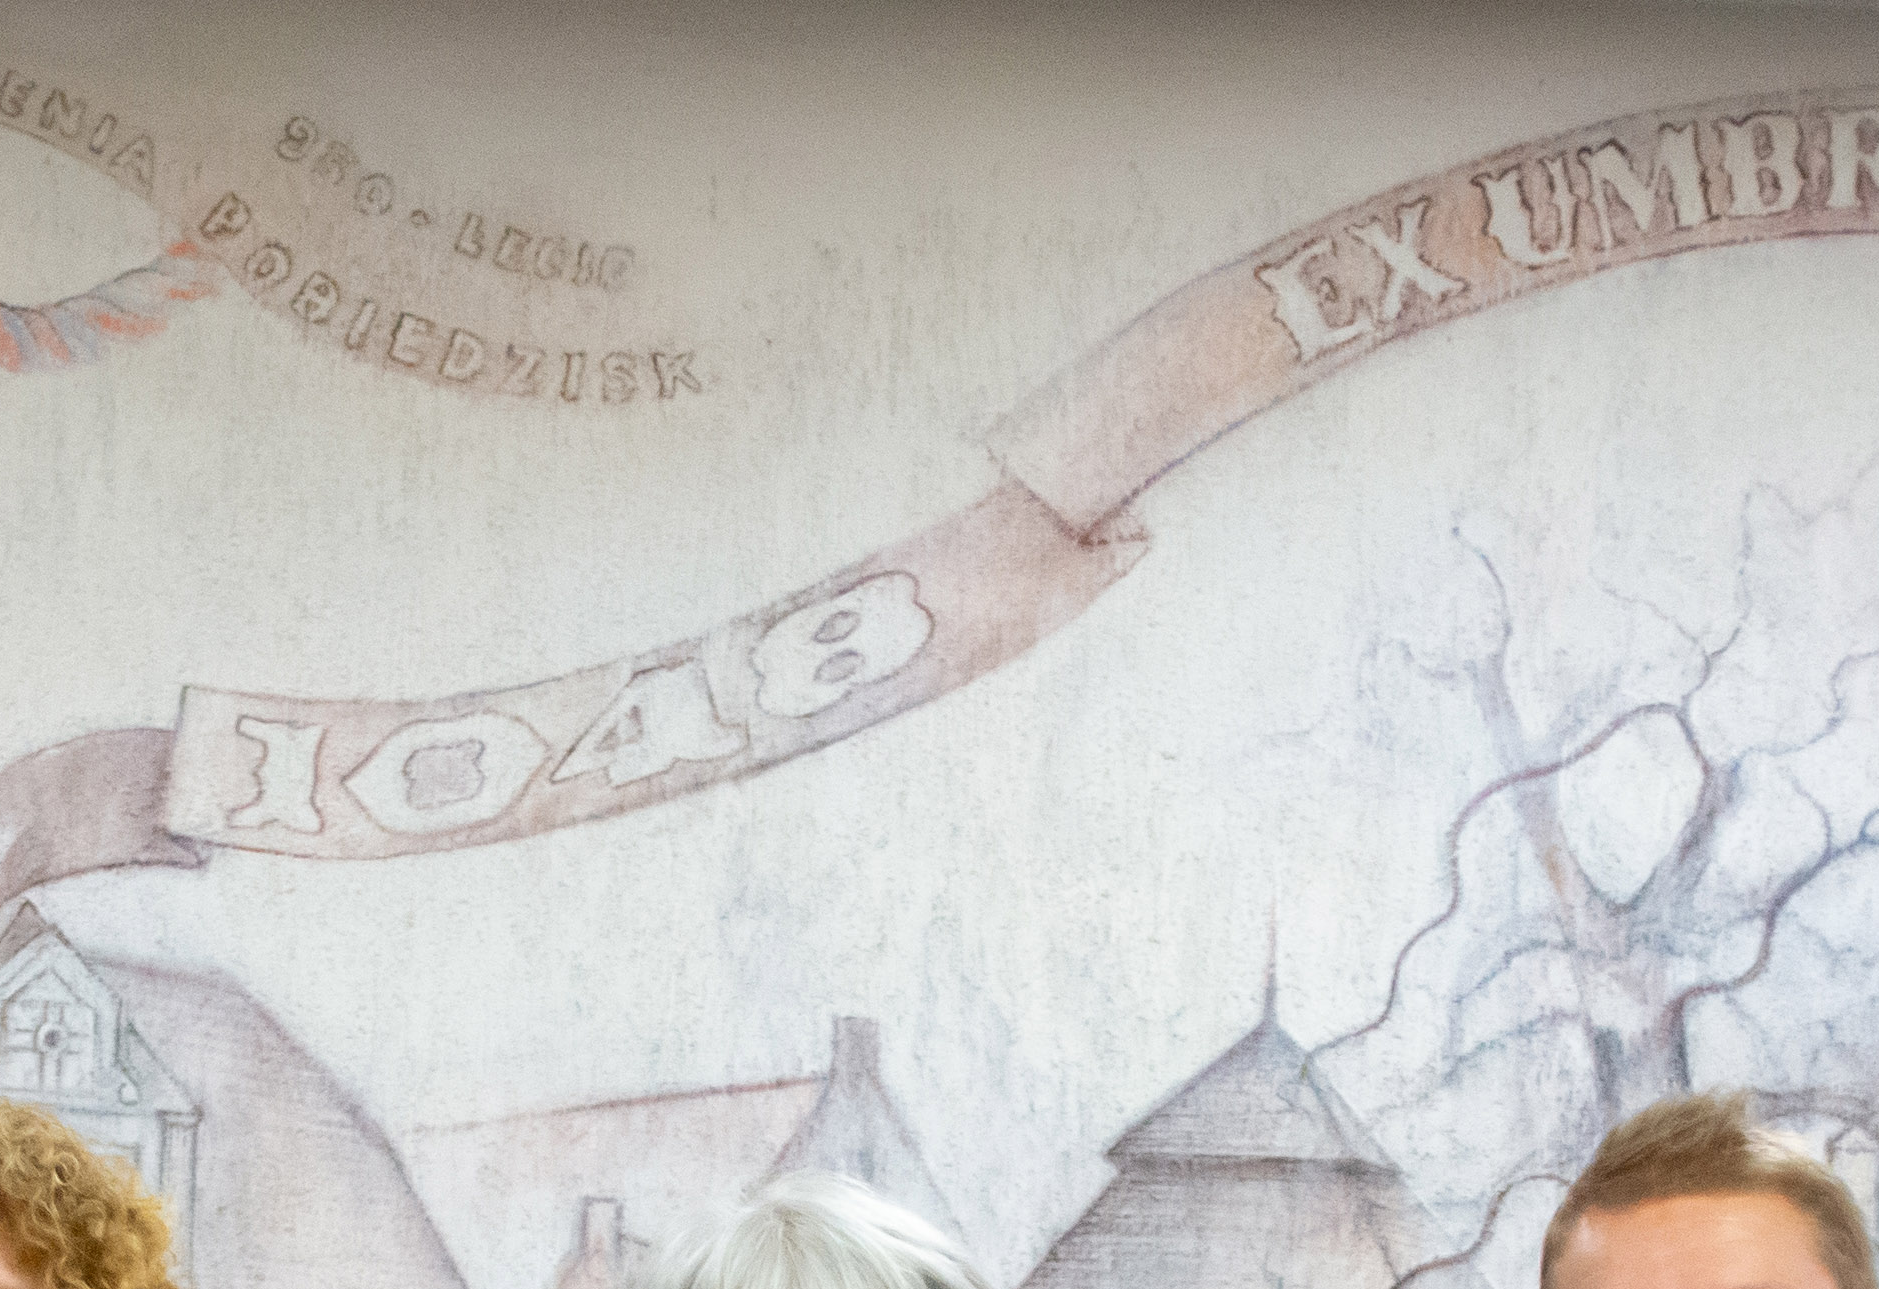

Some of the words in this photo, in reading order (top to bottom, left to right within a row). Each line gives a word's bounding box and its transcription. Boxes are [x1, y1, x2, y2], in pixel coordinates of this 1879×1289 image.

[201, 192, 702, 403] POBIEDZISK
[1254, 194, 1470, 366] EX
[225, 570, 936, 834] 1048
